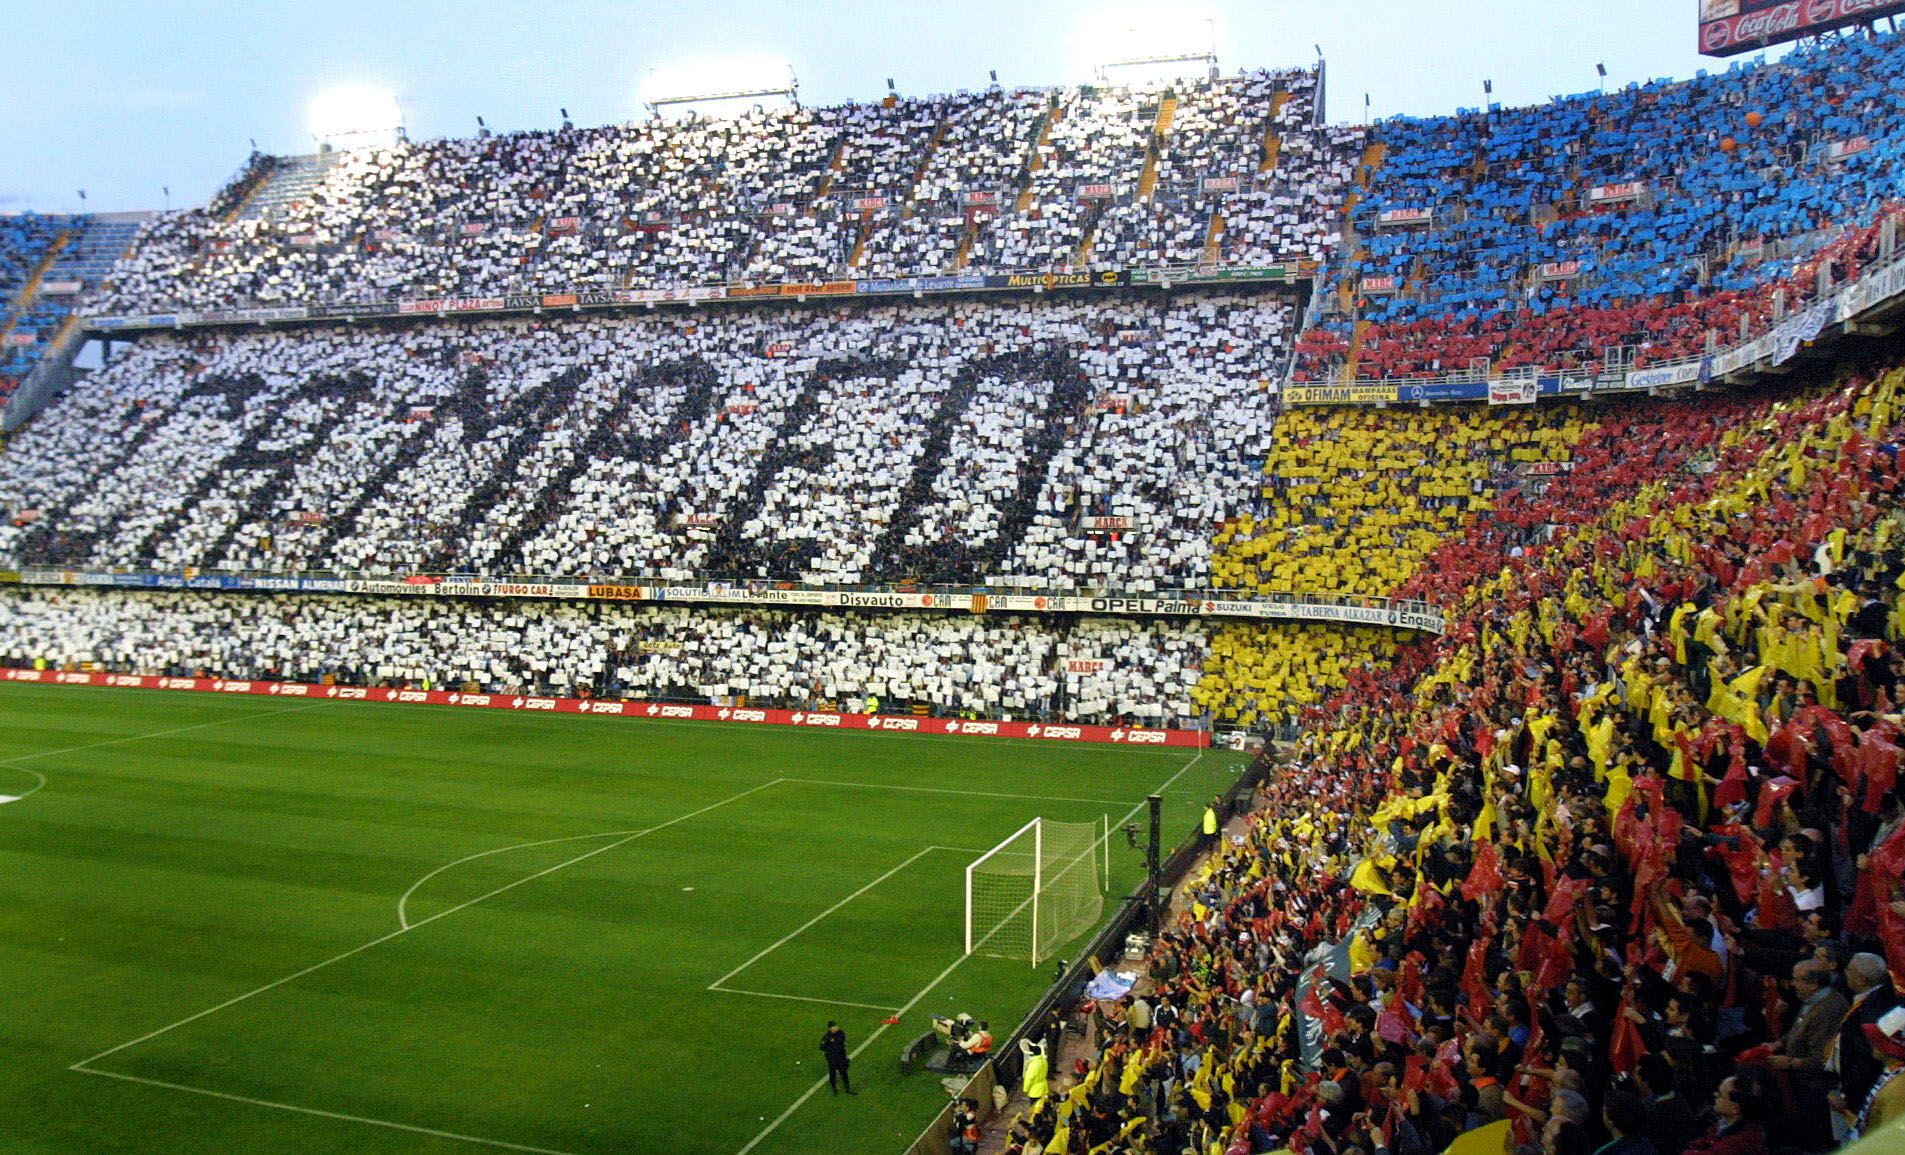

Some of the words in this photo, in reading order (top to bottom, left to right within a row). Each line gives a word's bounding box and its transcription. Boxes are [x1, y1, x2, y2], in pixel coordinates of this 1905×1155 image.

[1084, 184, 1114, 196] MARCA
[415, 300, 444, 312] NINOT
[450, 299, 481, 310] PLAZA
[506, 296, 540, 307] TAYSA
[1630, 371, 1673, 388] Gestetner
[1094, 517, 1128, 529] MARCA
[255, 578, 298, 590] NISSAN
[435, 582, 480, 595] Bertolin
[588, 586, 642, 598] LUBASA
[840, 592, 904, 607] Disvauto
[1091, 598, 1152, 612] OPEL
[1215, 603, 1252, 613] SUZUKI
[1302, 606, 1340, 619] TABERNA
[1343, 610, 1384, 622] ALKAZAR
[1068, 660, 1105, 673] MARCA
[525, 698, 556, 710] CEPSA
[592, 702, 623, 714] CEPSA
[661, 706, 693, 718] CEPSA
[732, 710, 766, 722] CEPSA
[806, 714, 840, 726] CEPSA
[883, 718, 918, 730] CEPSA
[962, 722, 998, 735] CEPSA
[1043, 726, 1081, 739] CEPSA
[1128, 730, 1166, 743] CEPSA
